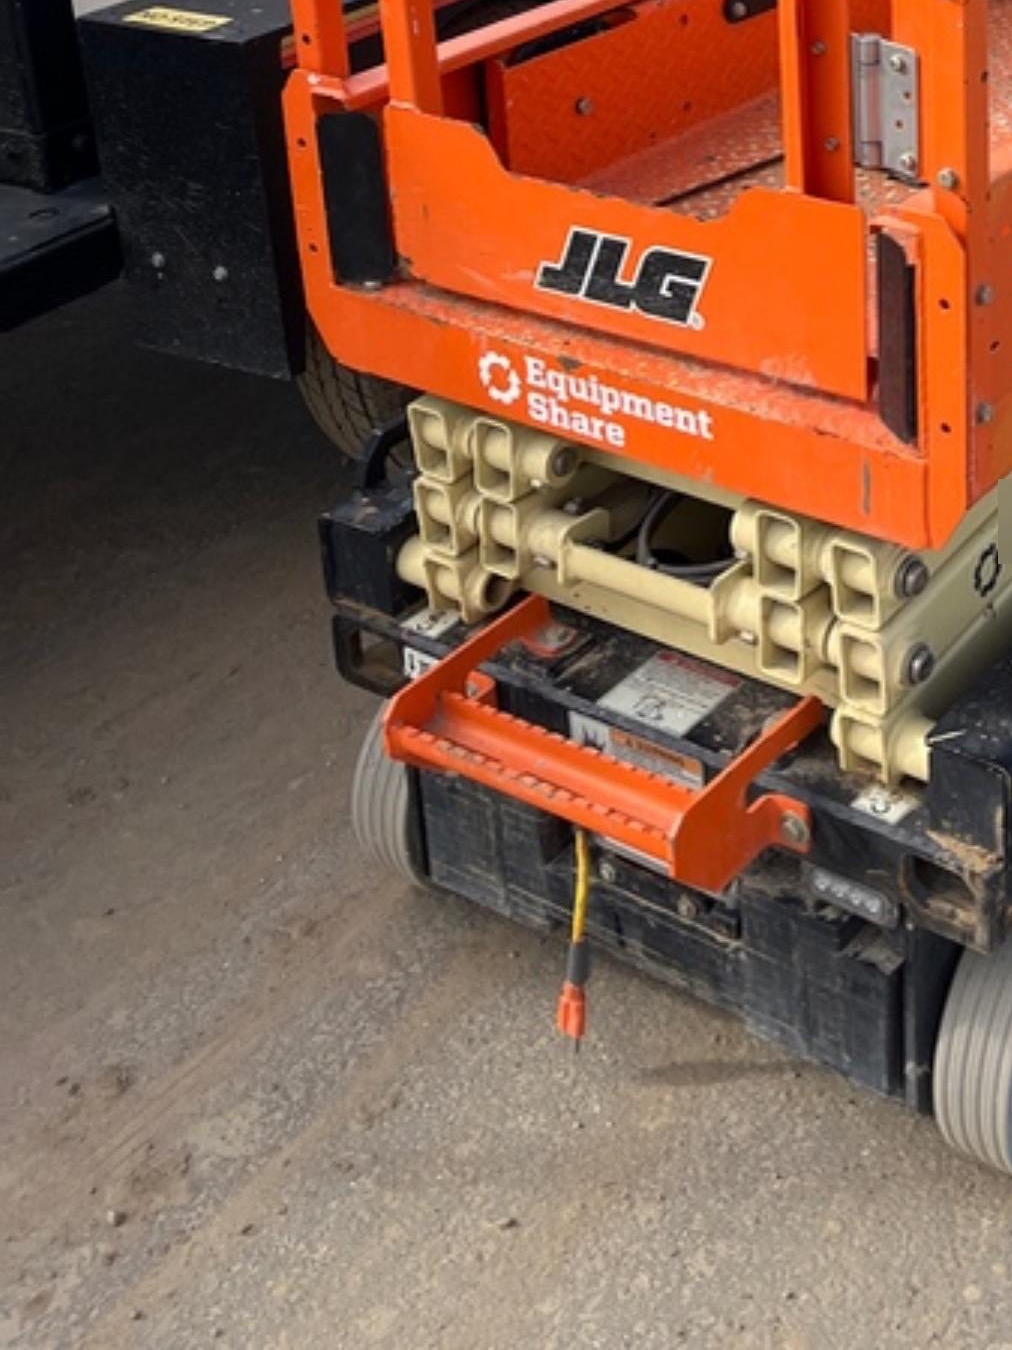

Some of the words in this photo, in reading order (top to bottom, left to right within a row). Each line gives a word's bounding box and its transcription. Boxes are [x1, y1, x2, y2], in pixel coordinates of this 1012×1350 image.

[534, 225, 712, 328] JLG
[523, 355, 714, 440] Equipment
[527, 391, 626, 447] Share
